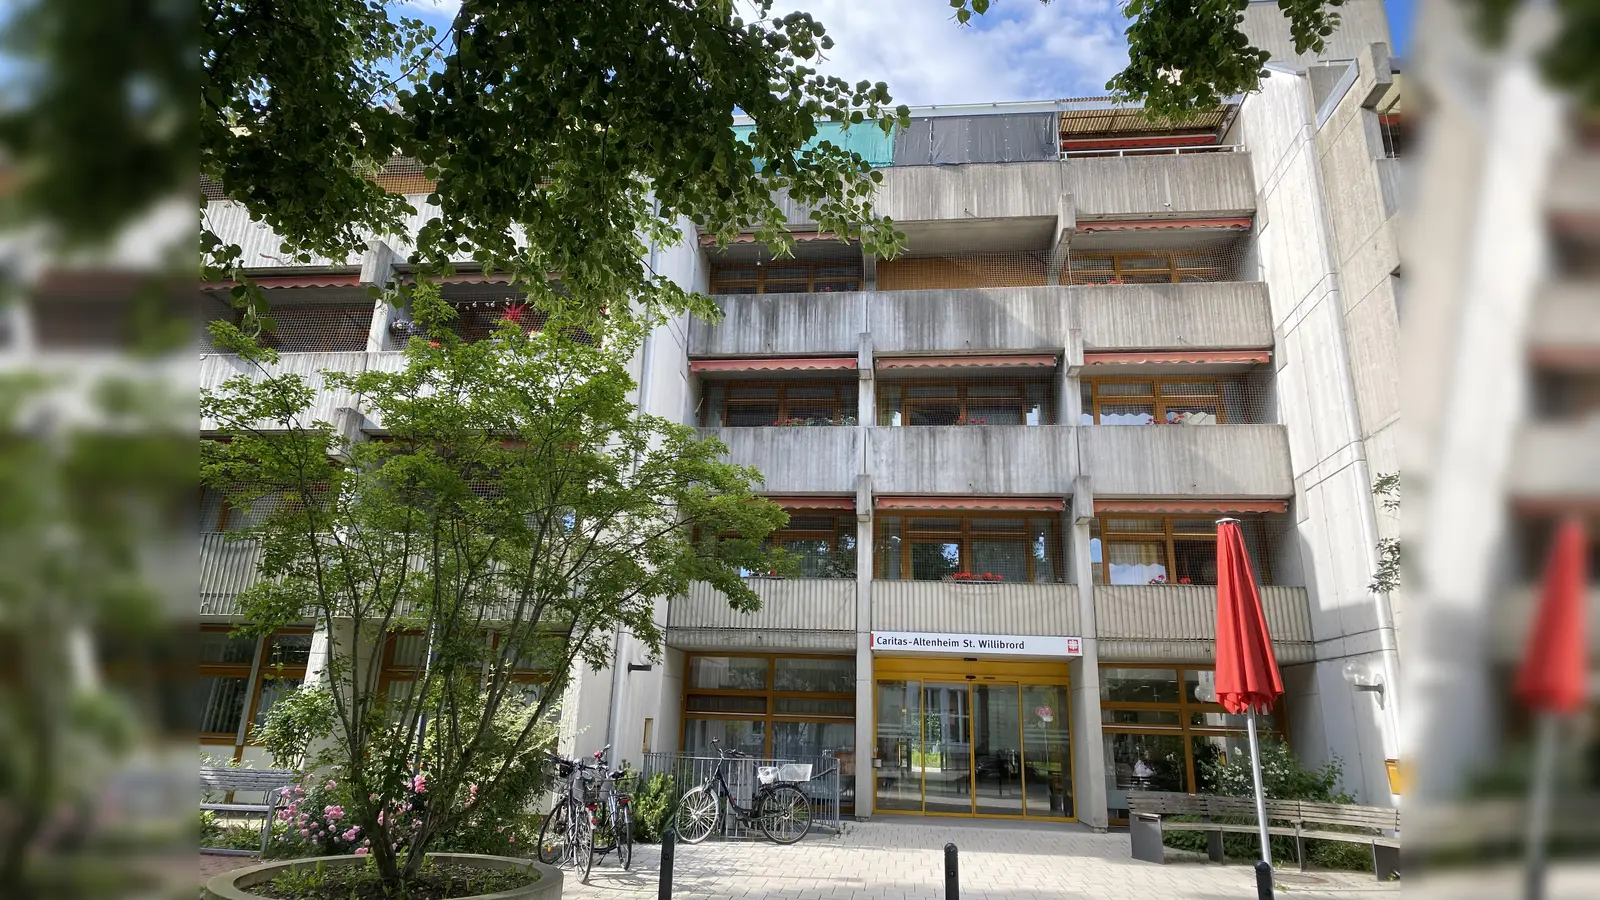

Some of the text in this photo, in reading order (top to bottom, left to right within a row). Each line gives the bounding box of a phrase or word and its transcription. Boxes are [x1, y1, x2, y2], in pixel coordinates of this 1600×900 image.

[876, 636, 1025, 650] Caritas-Altenheim St. Willibrord
